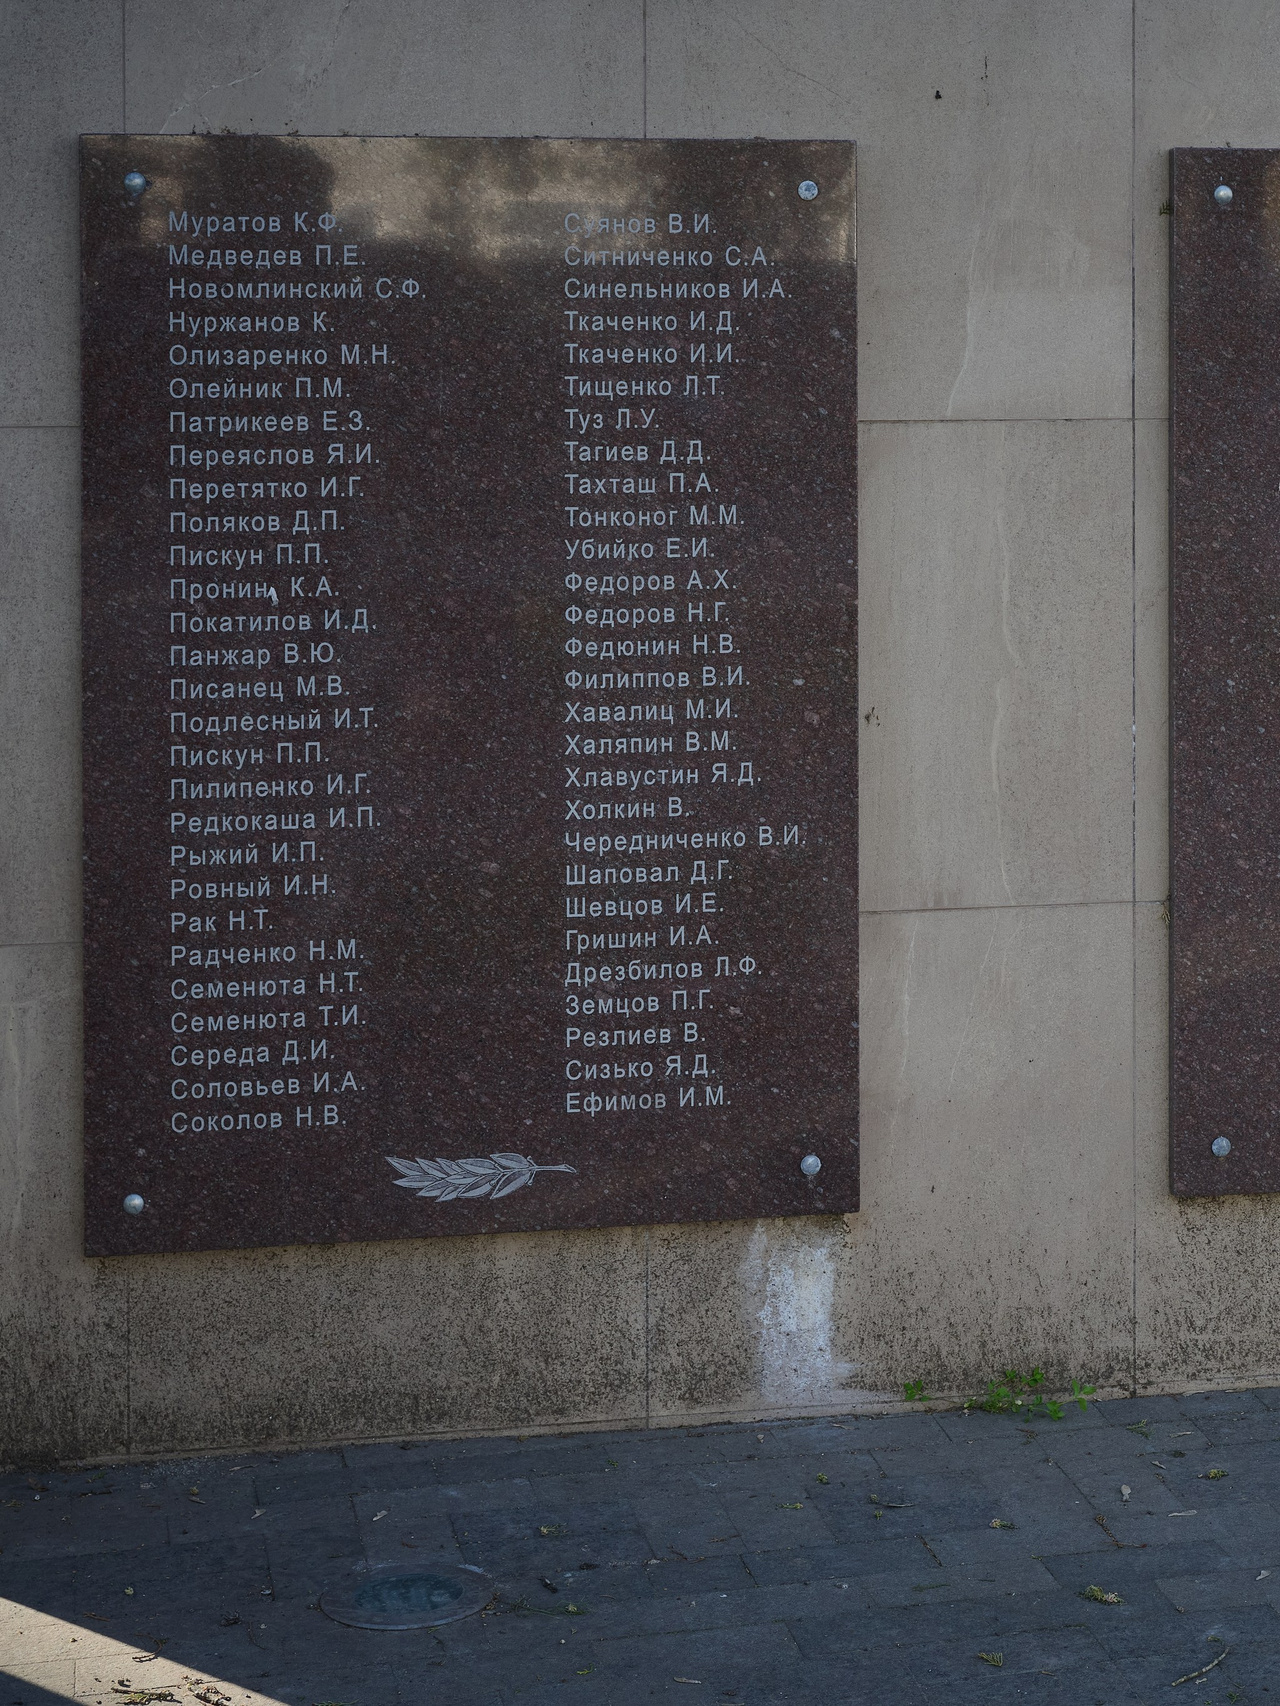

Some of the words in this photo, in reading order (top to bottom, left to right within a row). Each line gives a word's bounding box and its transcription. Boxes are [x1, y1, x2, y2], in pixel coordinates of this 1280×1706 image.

[168, 210, 281, 238] Муратов
[293, 211, 342, 233] К.Ф.
[564, 212, 656, 241] Суянов
[668, 213, 717, 234] В.И.
[168, 244, 302, 270] Медведев
[315, 244, 366, 266] П.Е.
[564, 245, 713, 267] Ситниченко
[725, 245, 775, 267] С.А.
[169, 276, 363, 299] Новомлинский
[375, 277, 426, 299] С.Ф.
[564, 277, 731, 299] Синельников
[742, 278, 791, 299] И.А.
[168, 311, 300, 338] Нуржанов
[313, 311, 335, 332] К.
[563, 310, 678, 332] Ткаченко
[690, 310, 740, 335] И.Д.
[169, 344, 328, 371] Олизаренко
[340, 343, 396, 365] М.Н.
[563, 342, 678, 364] Ткаченко
[690, 342, 740, 364] И.И.
[169, 377, 283, 399] Олейник
[295, 376, 351, 398] П.М.
[564, 375, 672, 401] Тищенко
[683, 374, 725, 399] Л.Т.
[169, 411, 309, 438] Патрикеев
[322, 409, 371, 431] Е.З.
[564, 408, 604, 435] Туз
[615, 407, 660, 431] Л.У.
[169, 444, 315, 471] Переяслов
[327, 442, 380, 464] Я.И.
[564, 441, 649, 462] Тагиев
[659, 439, 711, 465] Д.Д.
[169, 478, 308, 504] Перетятко
[320, 475, 364, 498] И.Г.
[564, 473, 656, 495] Тахташ
[669, 472, 719, 493] П.А.
[170, 511, 281, 533] Поляков
[292, 509, 345, 536] Д.П.
[564, 506, 678, 527] Тонконог
[689, 504, 745, 525] М.М.
[169, 545, 263, 571] Пискун
[276, 542, 329, 565] П.П.
[564, 538, 654, 562] Убийко
[666, 537, 715, 559] Е.И.
[170, 578, 270, 605] Пронин
[291, 575, 339, 598] К.А.
[564, 571, 676, 596] Федоров
[686, 568, 737, 590] А.Х.
[170, 611, 312, 633] Покатилов
[324, 608, 377, 634] И.Д.
[564, 604, 676, 629] Федоров
[687, 601, 729, 623] Н.Г.
[170, 645, 271, 670] Панжар
[284, 641, 341, 664] В.Ю.
[564, 636, 680, 661] Федюнин
[692, 633, 741, 655] Н.В.
[170, 678, 284, 702] Писанец
[296, 674, 350, 697] М.В.
[564, 669, 690, 690] Филиппов
[701, 665, 750, 687] В.И.
[170, 708, 321, 736] Подлесный
[334, 706, 378, 729] И.Т.
[564, 701, 674, 725] Хавалиц
[686, 697, 738, 720] М.И.
[170, 745, 264, 770] Пискун
[277, 741, 330, 764] П.П.
[564, 734, 673, 756] Халяпин
[685, 730, 737, 752] В.М.
[170, 778, 314, 800] Пилипенко
[327, 772, 371, 795] И.Г.
[564, 767, 699, 791] Хлавустин
[711, 761, 762, 787] Я.Д.
[170, 812, 316, 836] Редкокаша
[329, 805, 381, 828] И.П.
[564, 799, 656, 821] Холкин
[668, 796, 690, 817] В.
[170, 843, 258, 867] Рыжий
[272, 840, 324, 863] И.П.
[563, 830, 746, 857] Чередниченко
[758, 824, 806, 846] В.И.
[170, 875, 271, 900] Ровный
[284, 873, 336, 896] И.Н.
[565, 864, 679, 886] Шаповал
[690, 859, 733, 885] Д.Г.
[565, 896, 663, 921] Шевцов
[675, 891, 724, 914] И.Е.
[170, 912, 217, 933] Рак
[228, 908, 273, 931] Н.Т.
[171, 945, 297, 969] Радченко
[309, 938, 364, 961] Н.М.
[566, 929, 657, 955] Гришин
[669, 924, 719, 946] И.А.
[170, 978, 306, 1000] Семенюта
[319, 971, 363, 994] Н.Т.
[564, 959, 703, 988] Дрезбилов
[714, 955, 762, 977] Л.Ф.
[565, 994, 660, 1018] Земцов
[672, 988, 714, 1011] П.Г.
[170, 1011, 306, 1034] Семенюта
[318, 1004, 366, 1027] Т.И.
[566, 1027, 672, 1048] Резлиев
[683, 1021, 706, 1043] В.
[170, 1045, 270, 1070] Середа
[281, 1038, 335, 1066] Д.И.
[565, 1059, 654, 1081] Сизько
[665, 1053, 716, 1079] Я.Д.
[171, 1078, 301, 1100] Соловьев
[313, 1070, 366, 1093] И.А.
[566, 1091, 667, 1118] Ефимов
[679, 1085, 731, 1108] И.М.
[171, 1111, 283, 1134] Соколов
[296, 1104, 347, 1127] Н.В.
